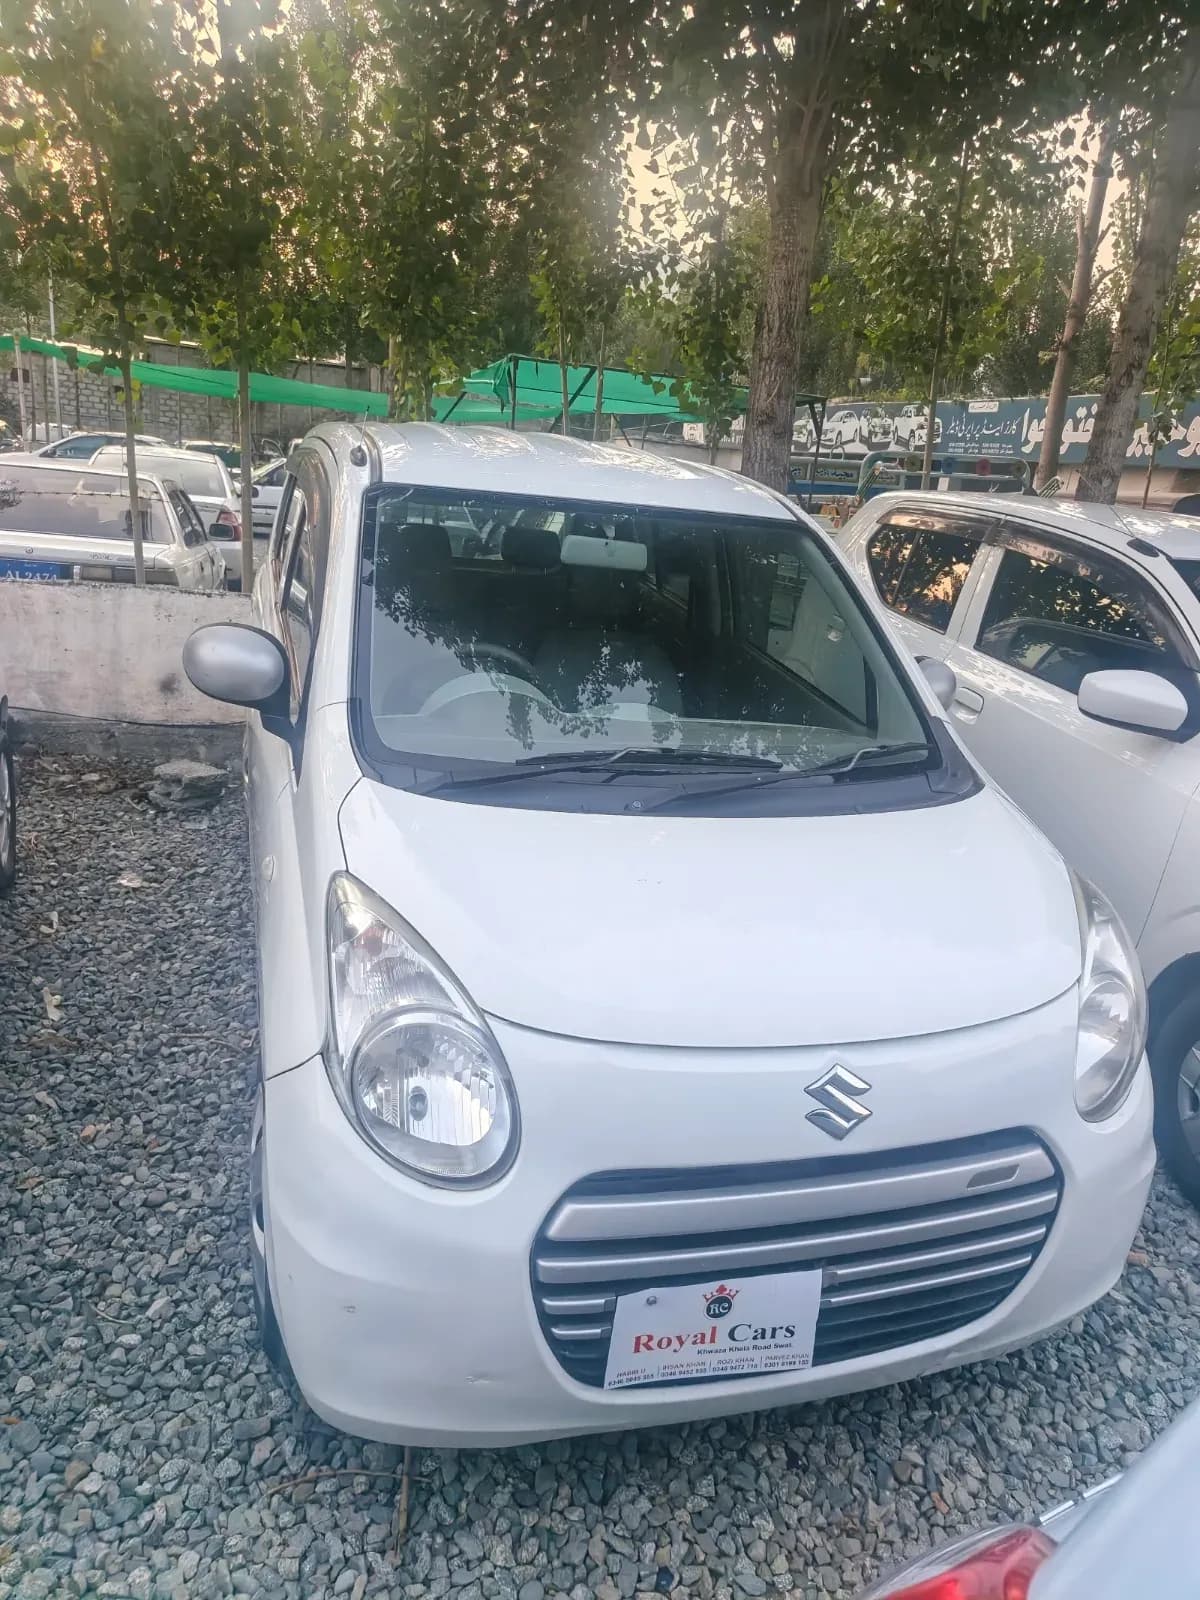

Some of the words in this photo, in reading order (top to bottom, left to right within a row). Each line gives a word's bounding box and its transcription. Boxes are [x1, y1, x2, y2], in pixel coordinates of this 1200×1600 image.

[708, 1301, 730, 1315] RC
[632, 1326, 717, 1353] Royal
[727, 1323, 796, 1342] Cars
[752, 1343, 772, 1351] Road
